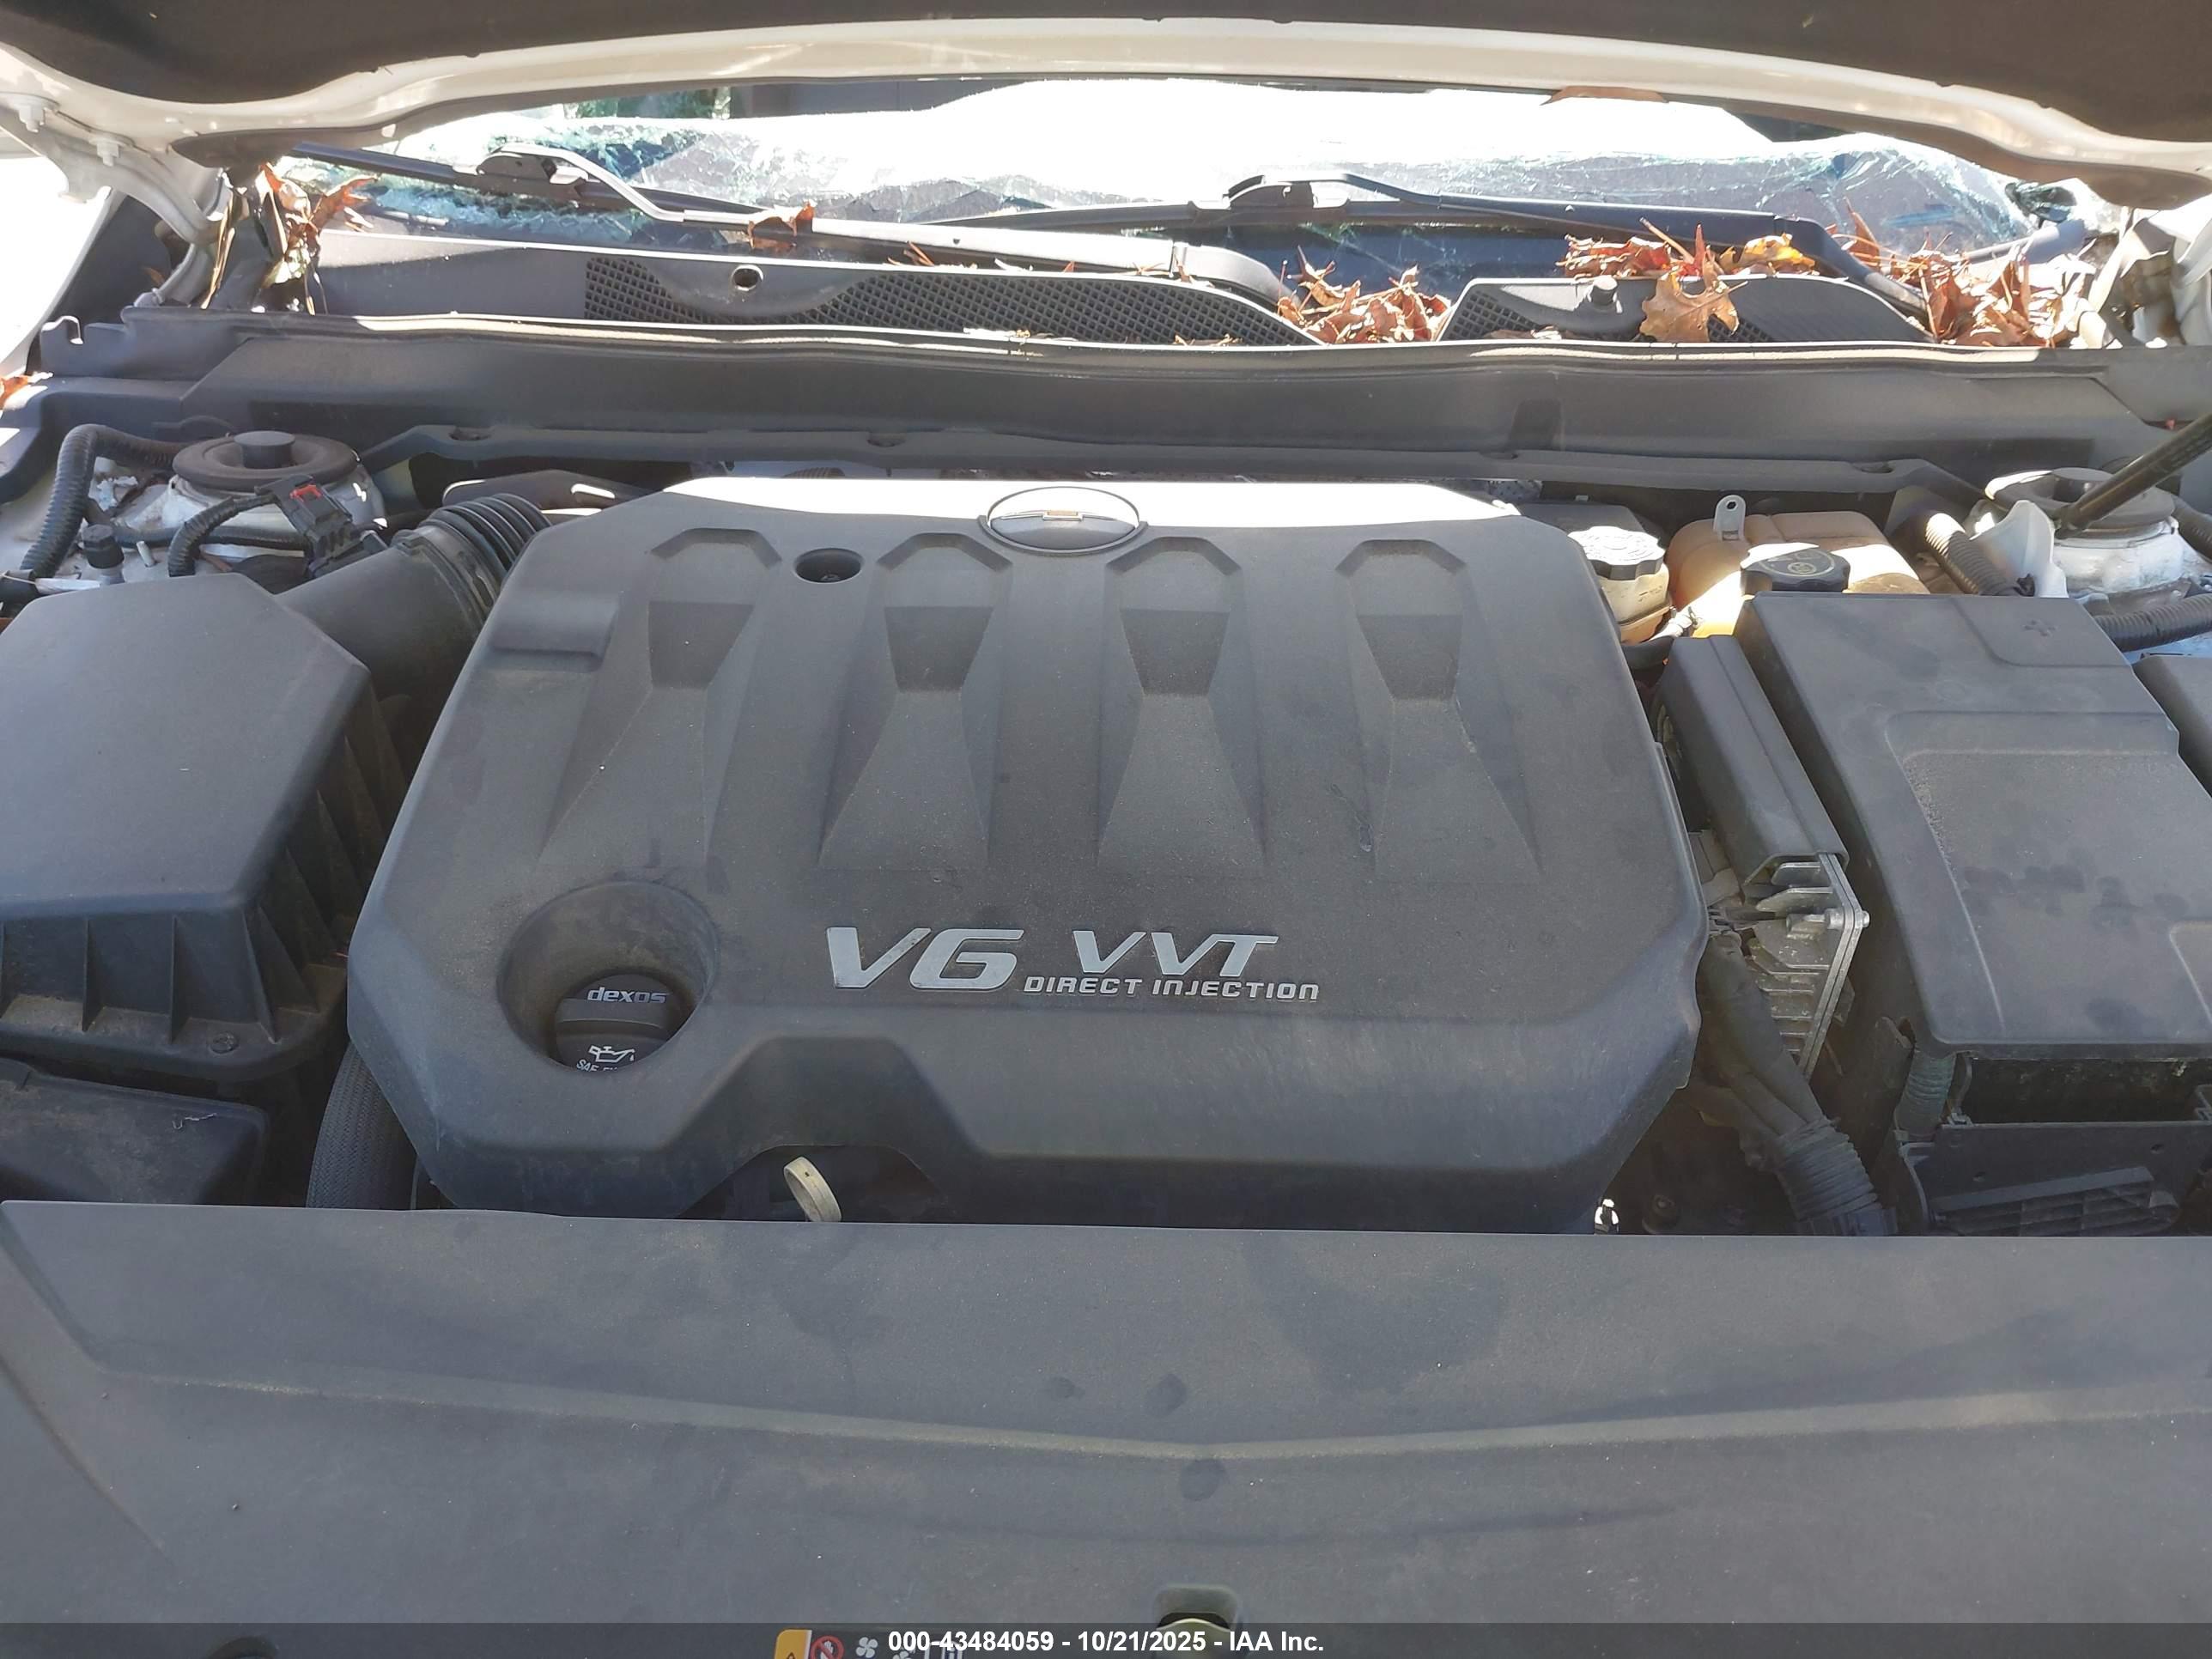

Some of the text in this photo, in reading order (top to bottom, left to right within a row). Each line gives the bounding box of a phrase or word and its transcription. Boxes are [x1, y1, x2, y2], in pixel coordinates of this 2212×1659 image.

[826, 927, 1279, 990] V6 VVT
[587, 987, 669, 1004] dexos
[1024, 975, 1320, 1001] DIRECT INJECTION
